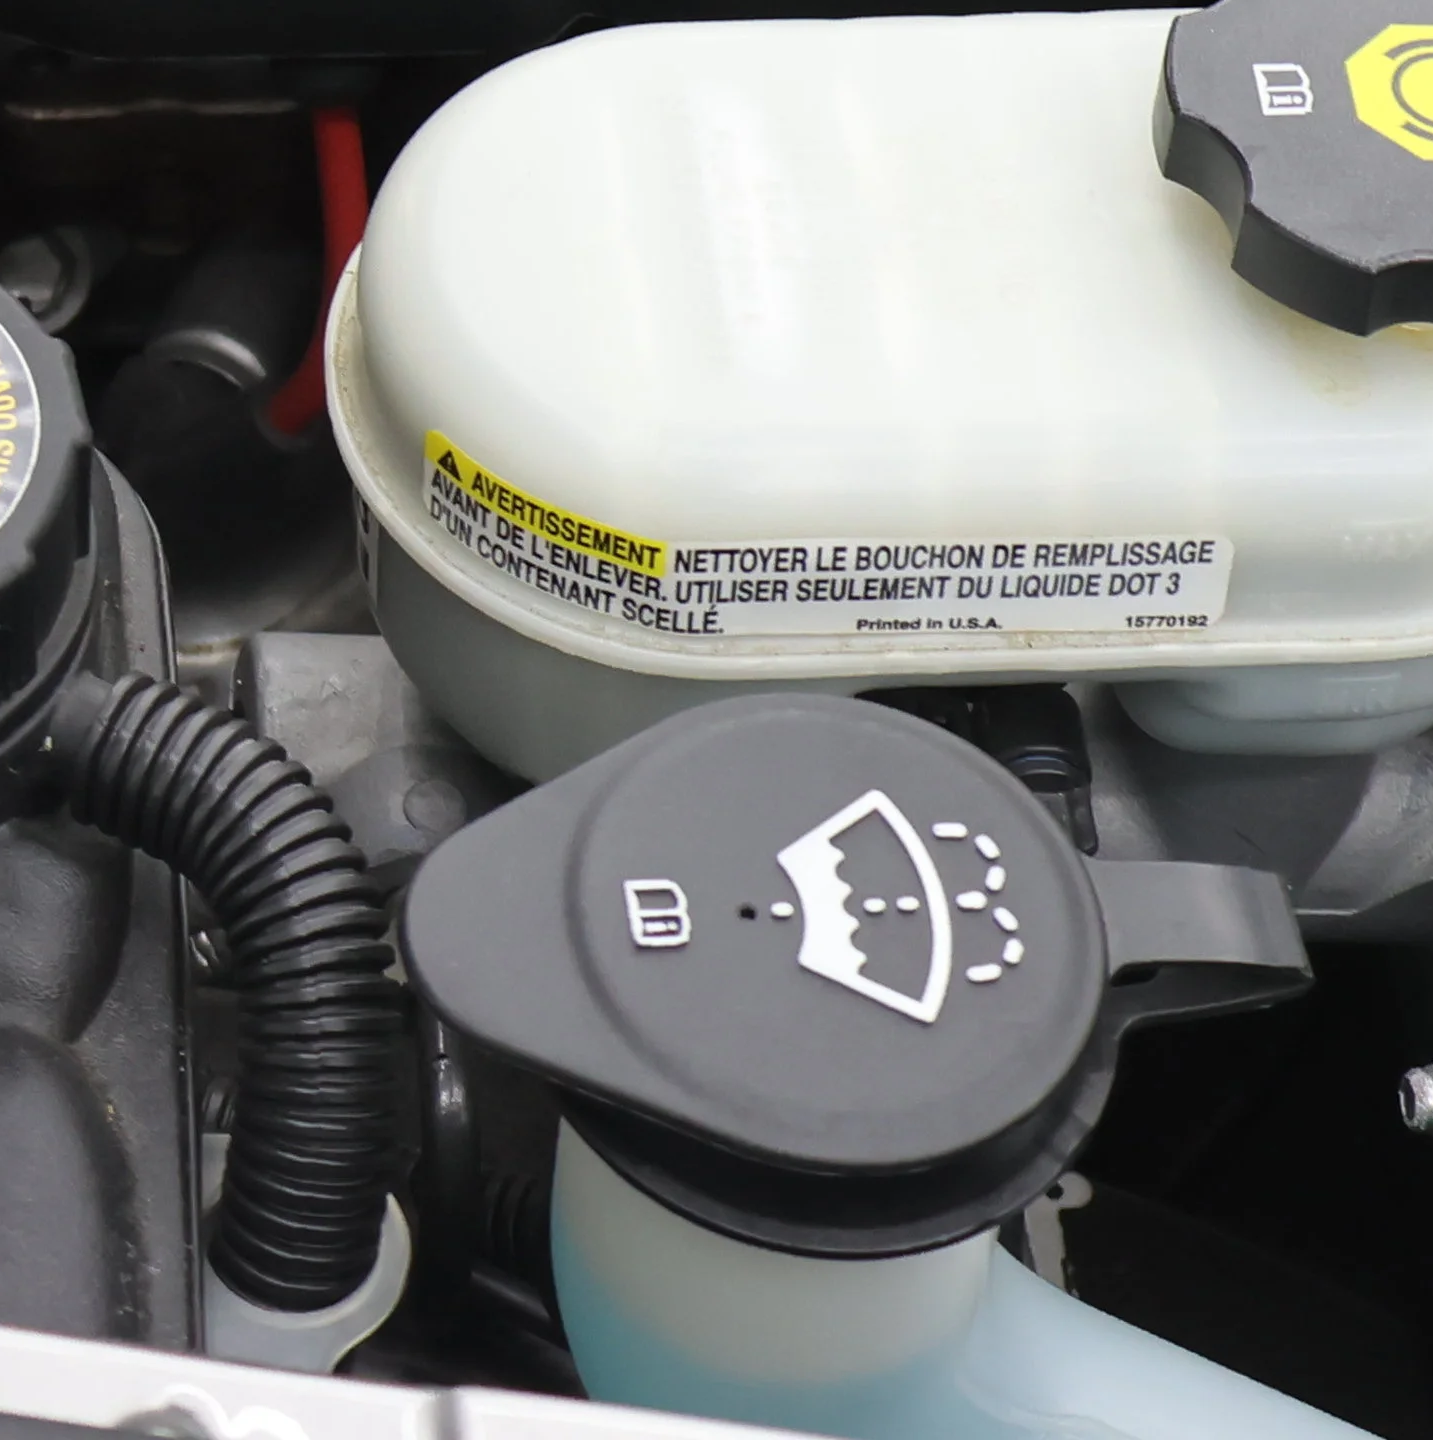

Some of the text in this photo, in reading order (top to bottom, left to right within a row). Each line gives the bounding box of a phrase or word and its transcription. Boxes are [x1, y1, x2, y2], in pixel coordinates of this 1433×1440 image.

[430, 494, 472, 548] D'UN
[477, 534, 617, 614] CONTENANT
[621, 604, 724, 635] SCELLÉ.
[431, 468, 1182, 605] AVANT DE L'ENLEVER. UTILISER SEULEMENT DU LIQUIDE DOT 3
[471, 470, 1216, 573] AVERTISSEMENT NETTOYER LE BOUCHON DE REMPLISSAGE
[856, 615, 1209, 631] Printed in U.S.A. 15770192
